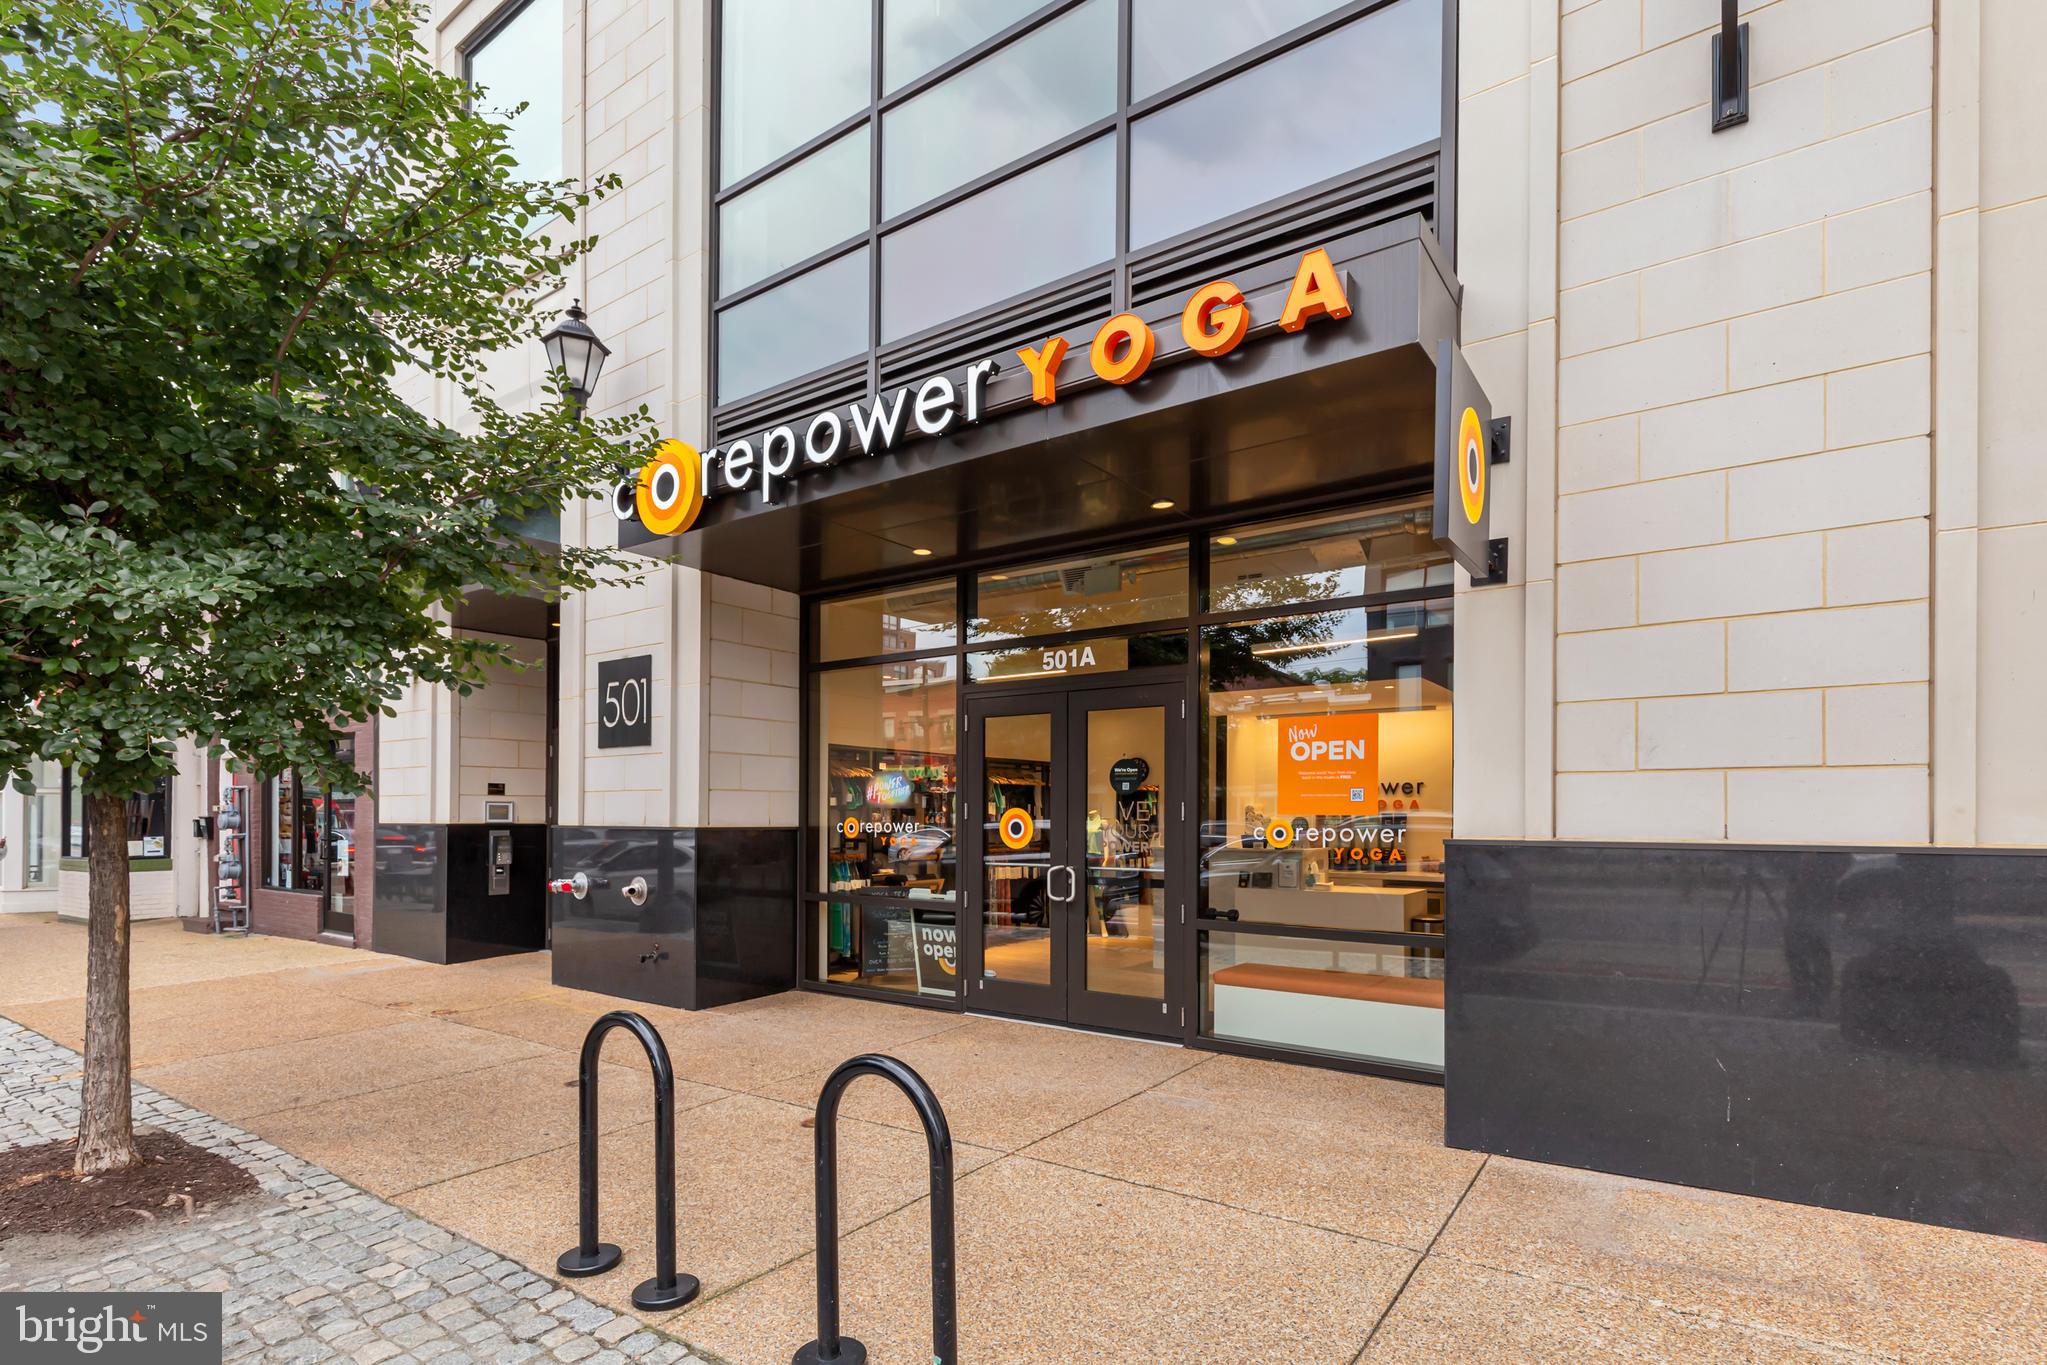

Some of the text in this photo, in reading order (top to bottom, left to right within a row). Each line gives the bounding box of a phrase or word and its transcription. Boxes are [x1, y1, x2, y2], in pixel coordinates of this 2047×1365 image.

[612, 247, 1354, 535] corepower YOGA
[1042, 646, 1096, 670] 501A
[603, 677, 648, 728] 501
[1288, 724, 1318, 742] Now
[1290, 739, 1365, 761] OPEN
[836, 817, 920, 838] corepower
[1253, 818, 1407, 849] corepower
[1333, 848, 1402, 861] YOGA
